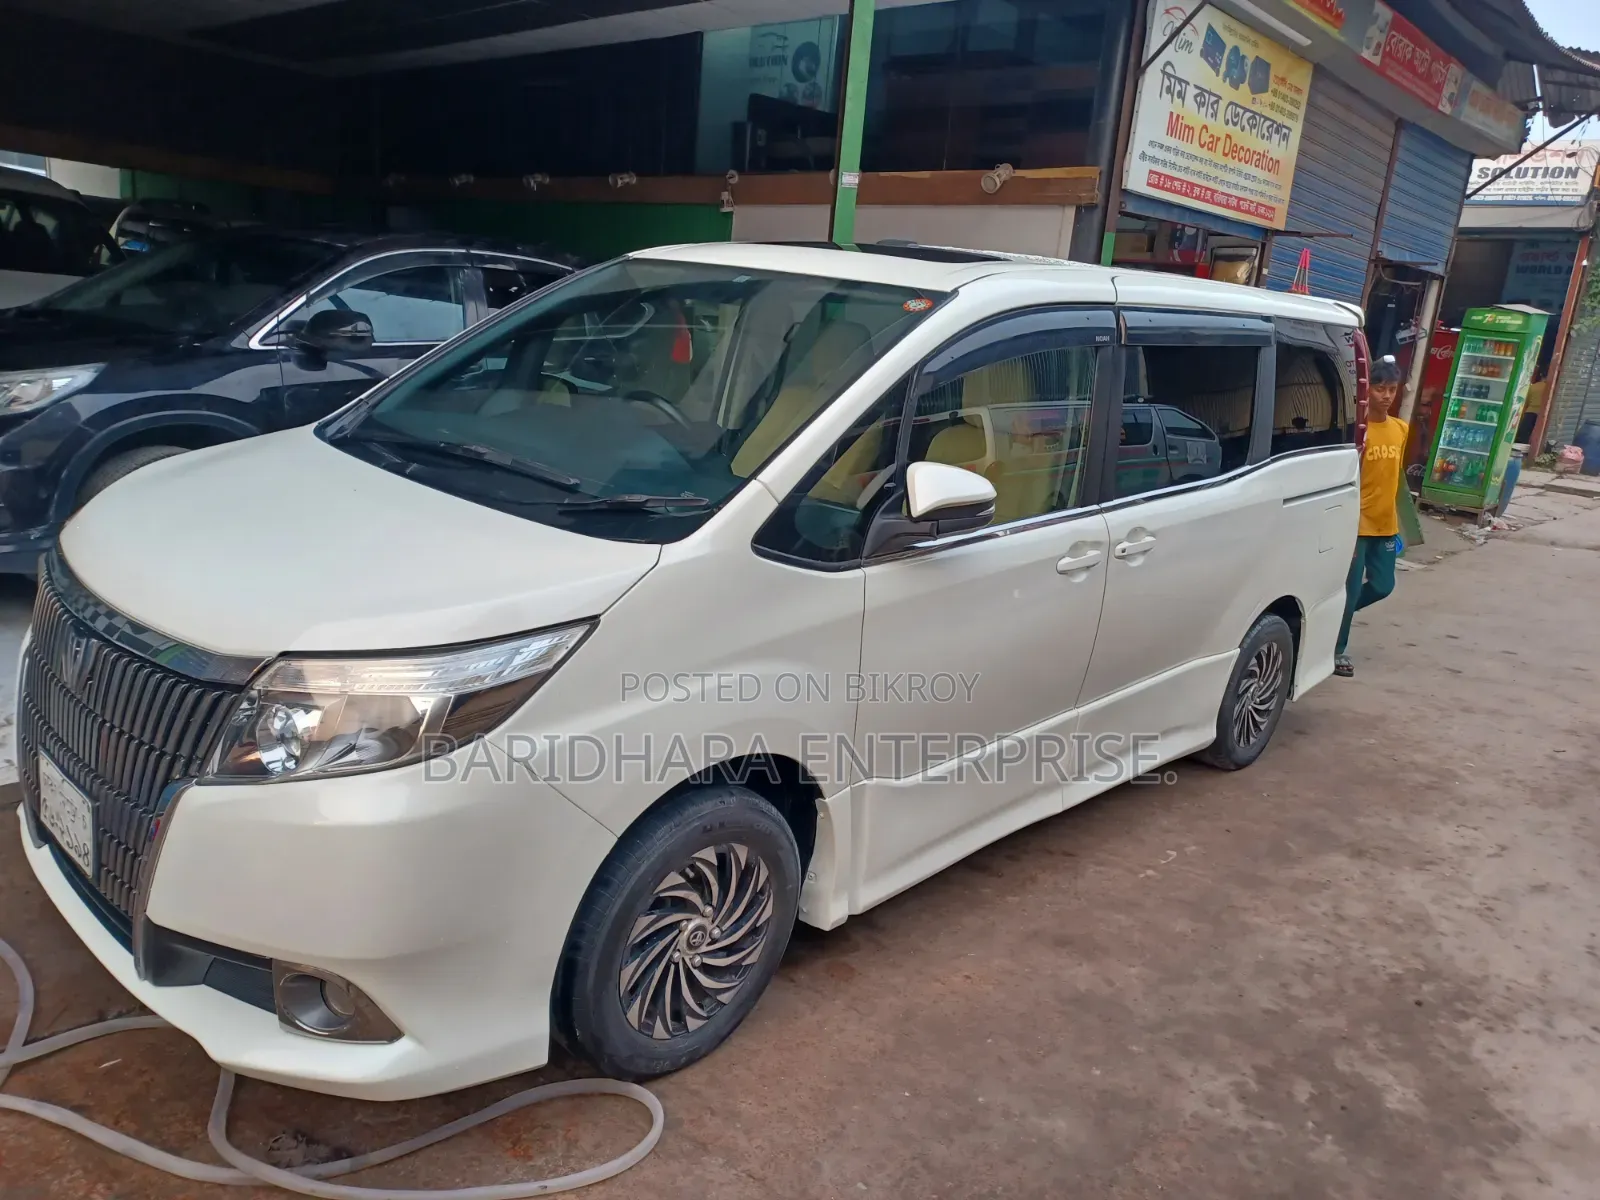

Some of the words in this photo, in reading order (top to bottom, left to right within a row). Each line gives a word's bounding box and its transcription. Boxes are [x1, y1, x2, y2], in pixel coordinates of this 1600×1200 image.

[1159, 60, 1190, 108] মিম
[1193, 84, 1222, 122] কার
[1224, 100, 1293, 150] ডেকোরেশন
[1166, 111, 1195, 145] Mim
[1198, 124, 1221, 156] Car
[1222, 133, 1281, 176] Decoration
[1477, 166, 1581, 179] SOLUTION
